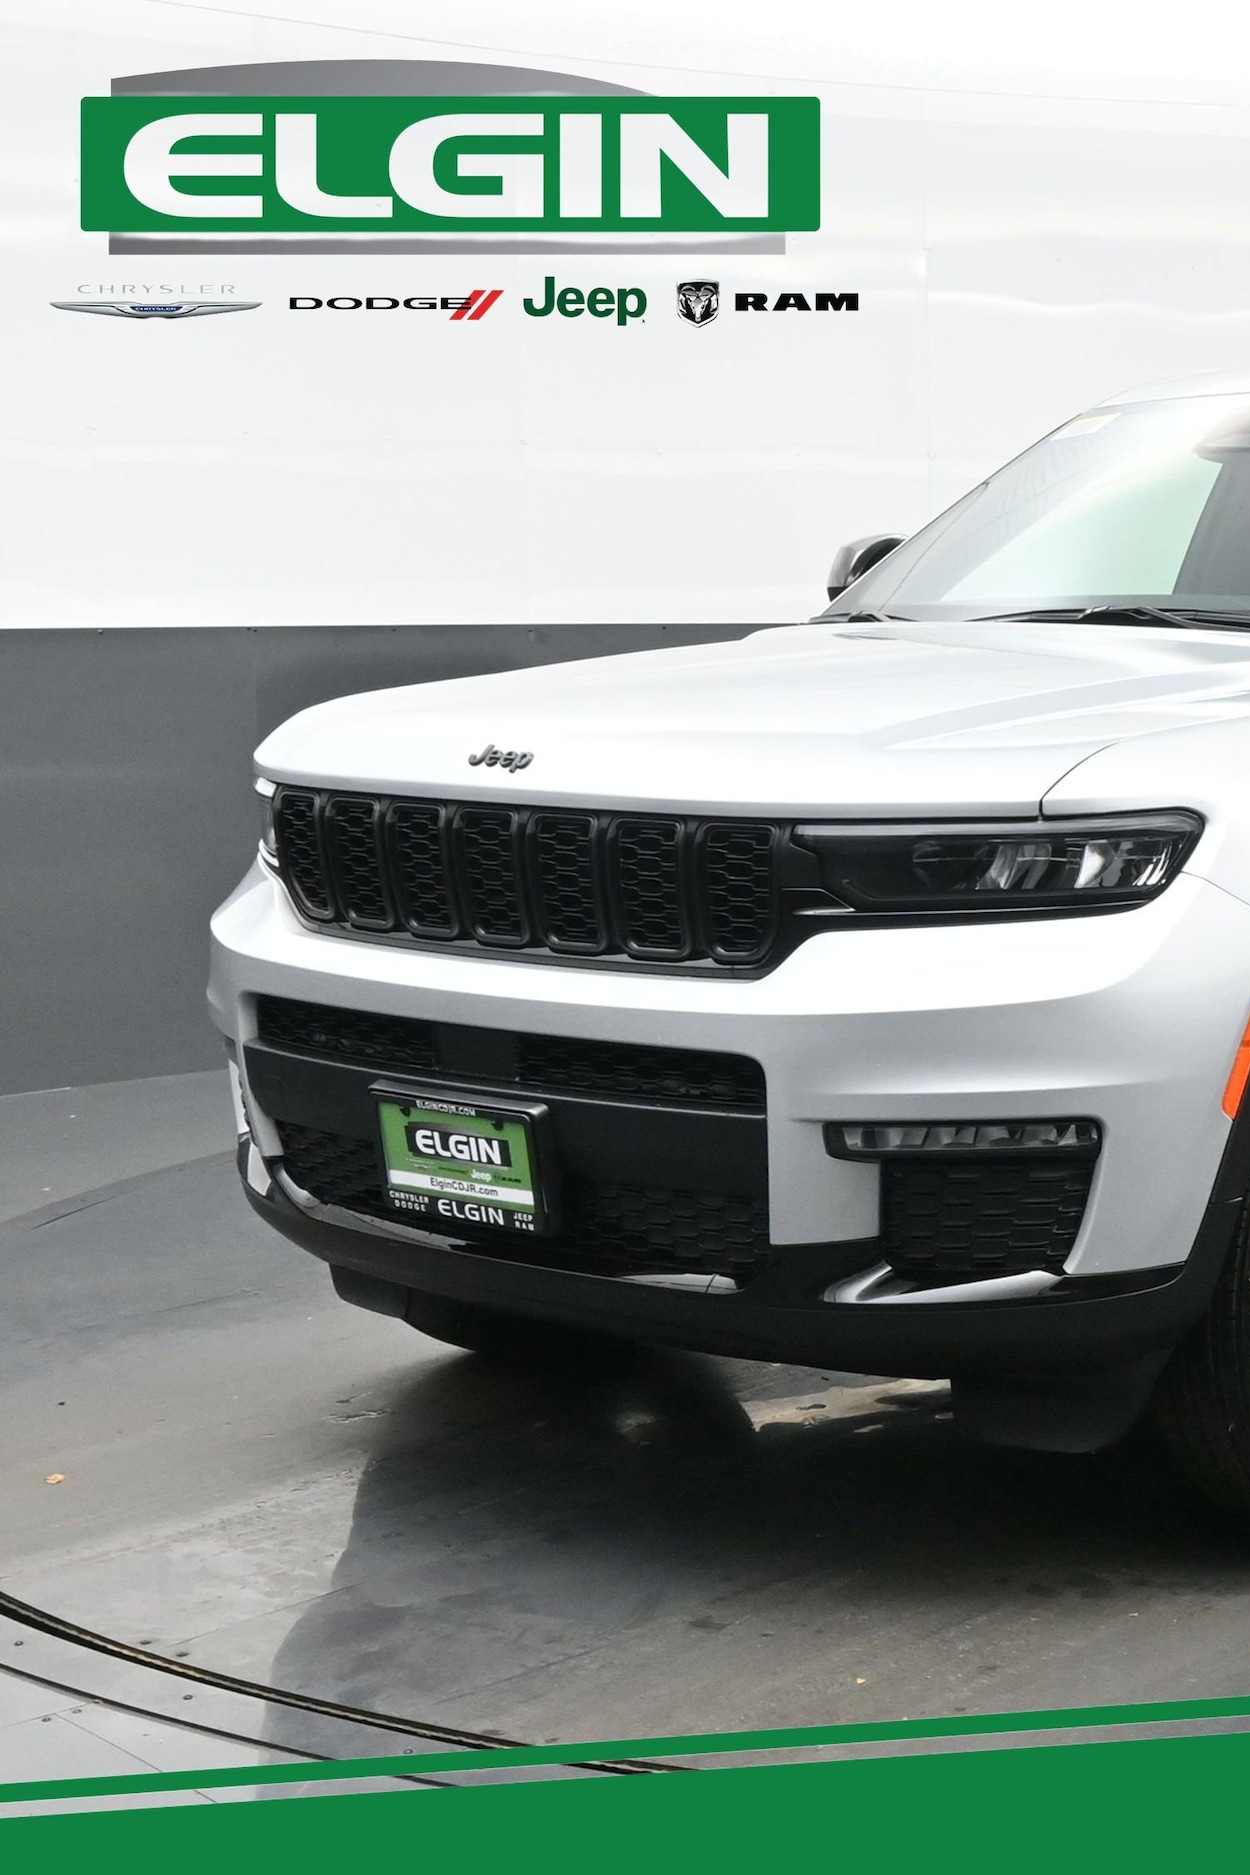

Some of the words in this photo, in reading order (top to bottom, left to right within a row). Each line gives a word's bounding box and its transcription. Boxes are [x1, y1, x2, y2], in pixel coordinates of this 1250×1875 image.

[468, 744, 535, 774] Jeep
[415, 1128, 502, 1165] ELGIN
[429, 1176, 499, 1198] ElginCDJR.com
[389, 1190, 429, 1204] CHRYSLER
[395, 1199, 427, 1212] DODGE
[436, 1198, 505, 1226] ELGIN
[513, 1212, 533, 1222] JEEP
[515, 1221, 535, 1231] RAM
